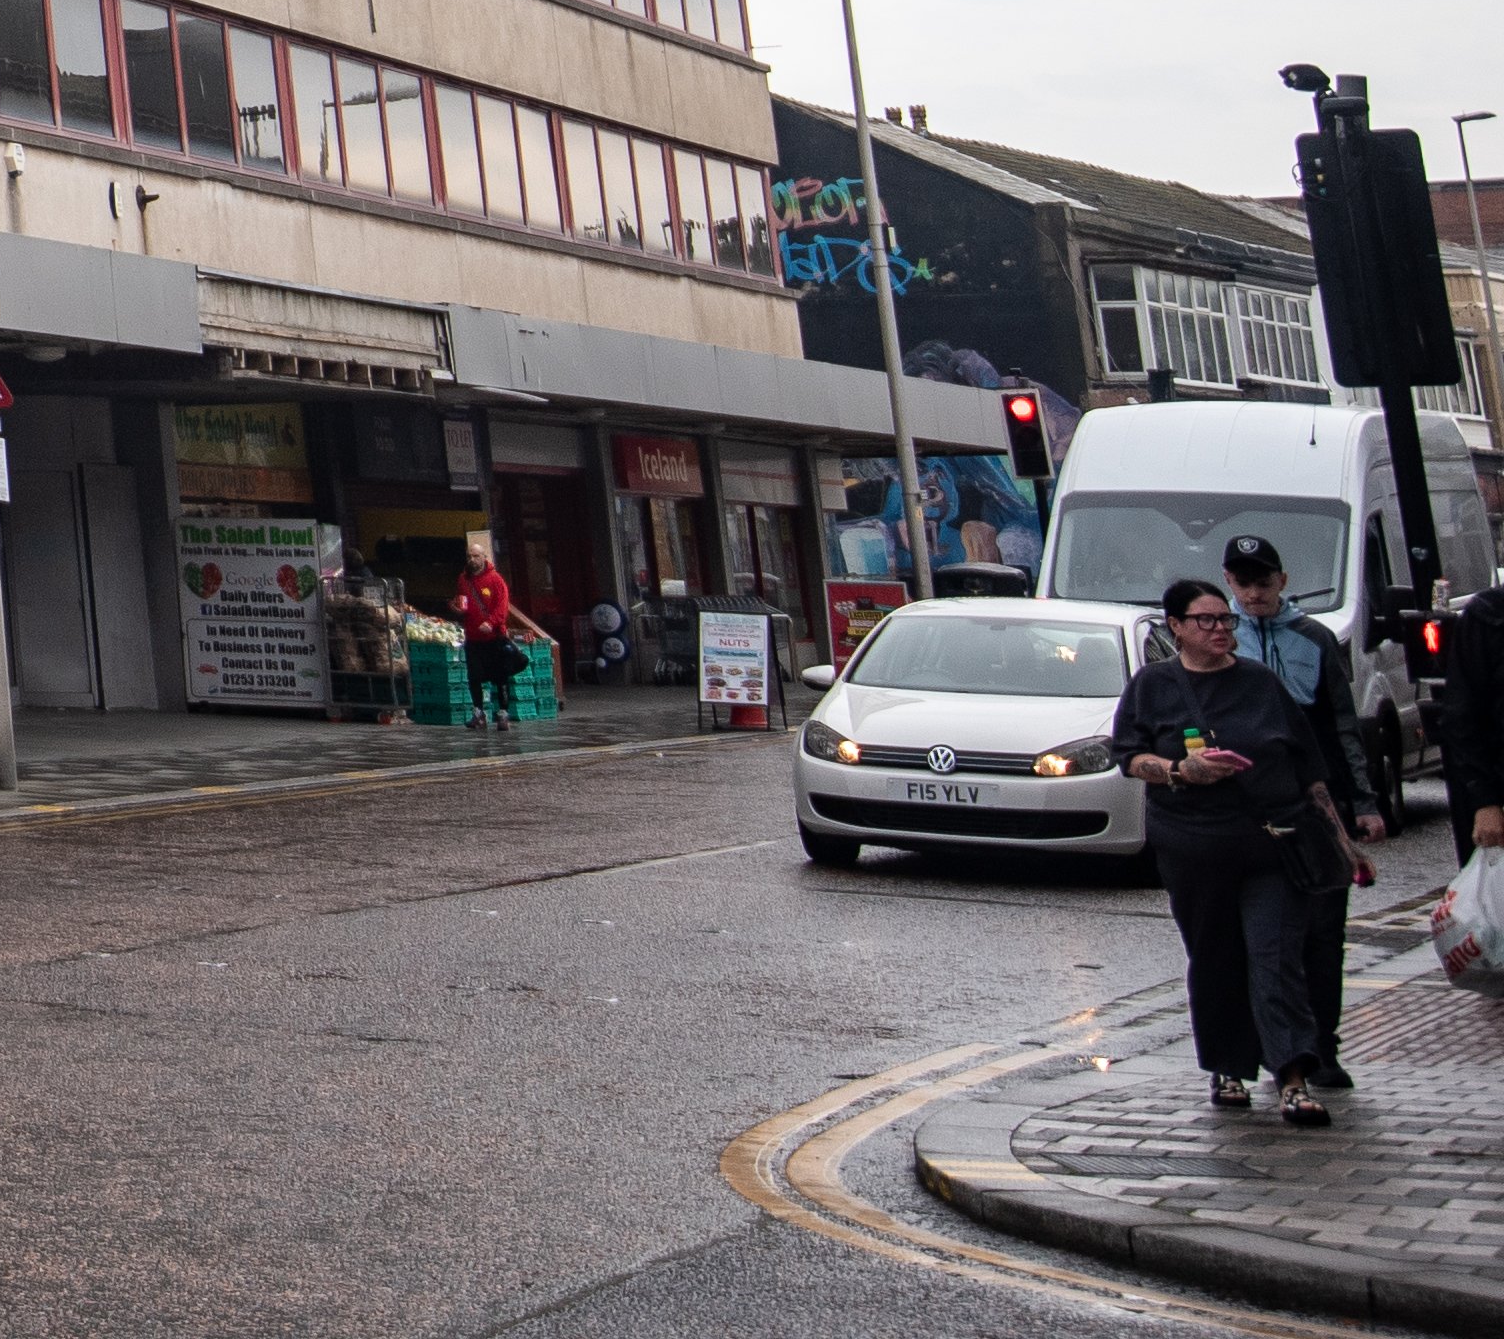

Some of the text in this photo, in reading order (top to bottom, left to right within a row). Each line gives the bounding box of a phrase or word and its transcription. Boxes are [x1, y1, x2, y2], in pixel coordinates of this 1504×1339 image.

[638, 446, 688, 482] Iceland
[180, 524, 313, 545] The Salad Bowl
[181, 546, 202, 555] Fresh
[204, 547, 223, 556] Fruit
[256, 548, 274, 556] Plus
[276, 548, 292, 557] Lots
[294, 549, 314, 557] More
[226, 570, 273, 589] Google
[220, 590, 284, 603] Daily Offers
[206, 624, 305, 640] In Need Of Delivery
[198, 640, 315, 655] To Business Or Home?
[719, 638, 750, 647] NUTS
[222, 657, 294, 671] Contact Us On
[223, 674, 254, 685] 01253
[907, 782, 979, 804] F15 YLV
